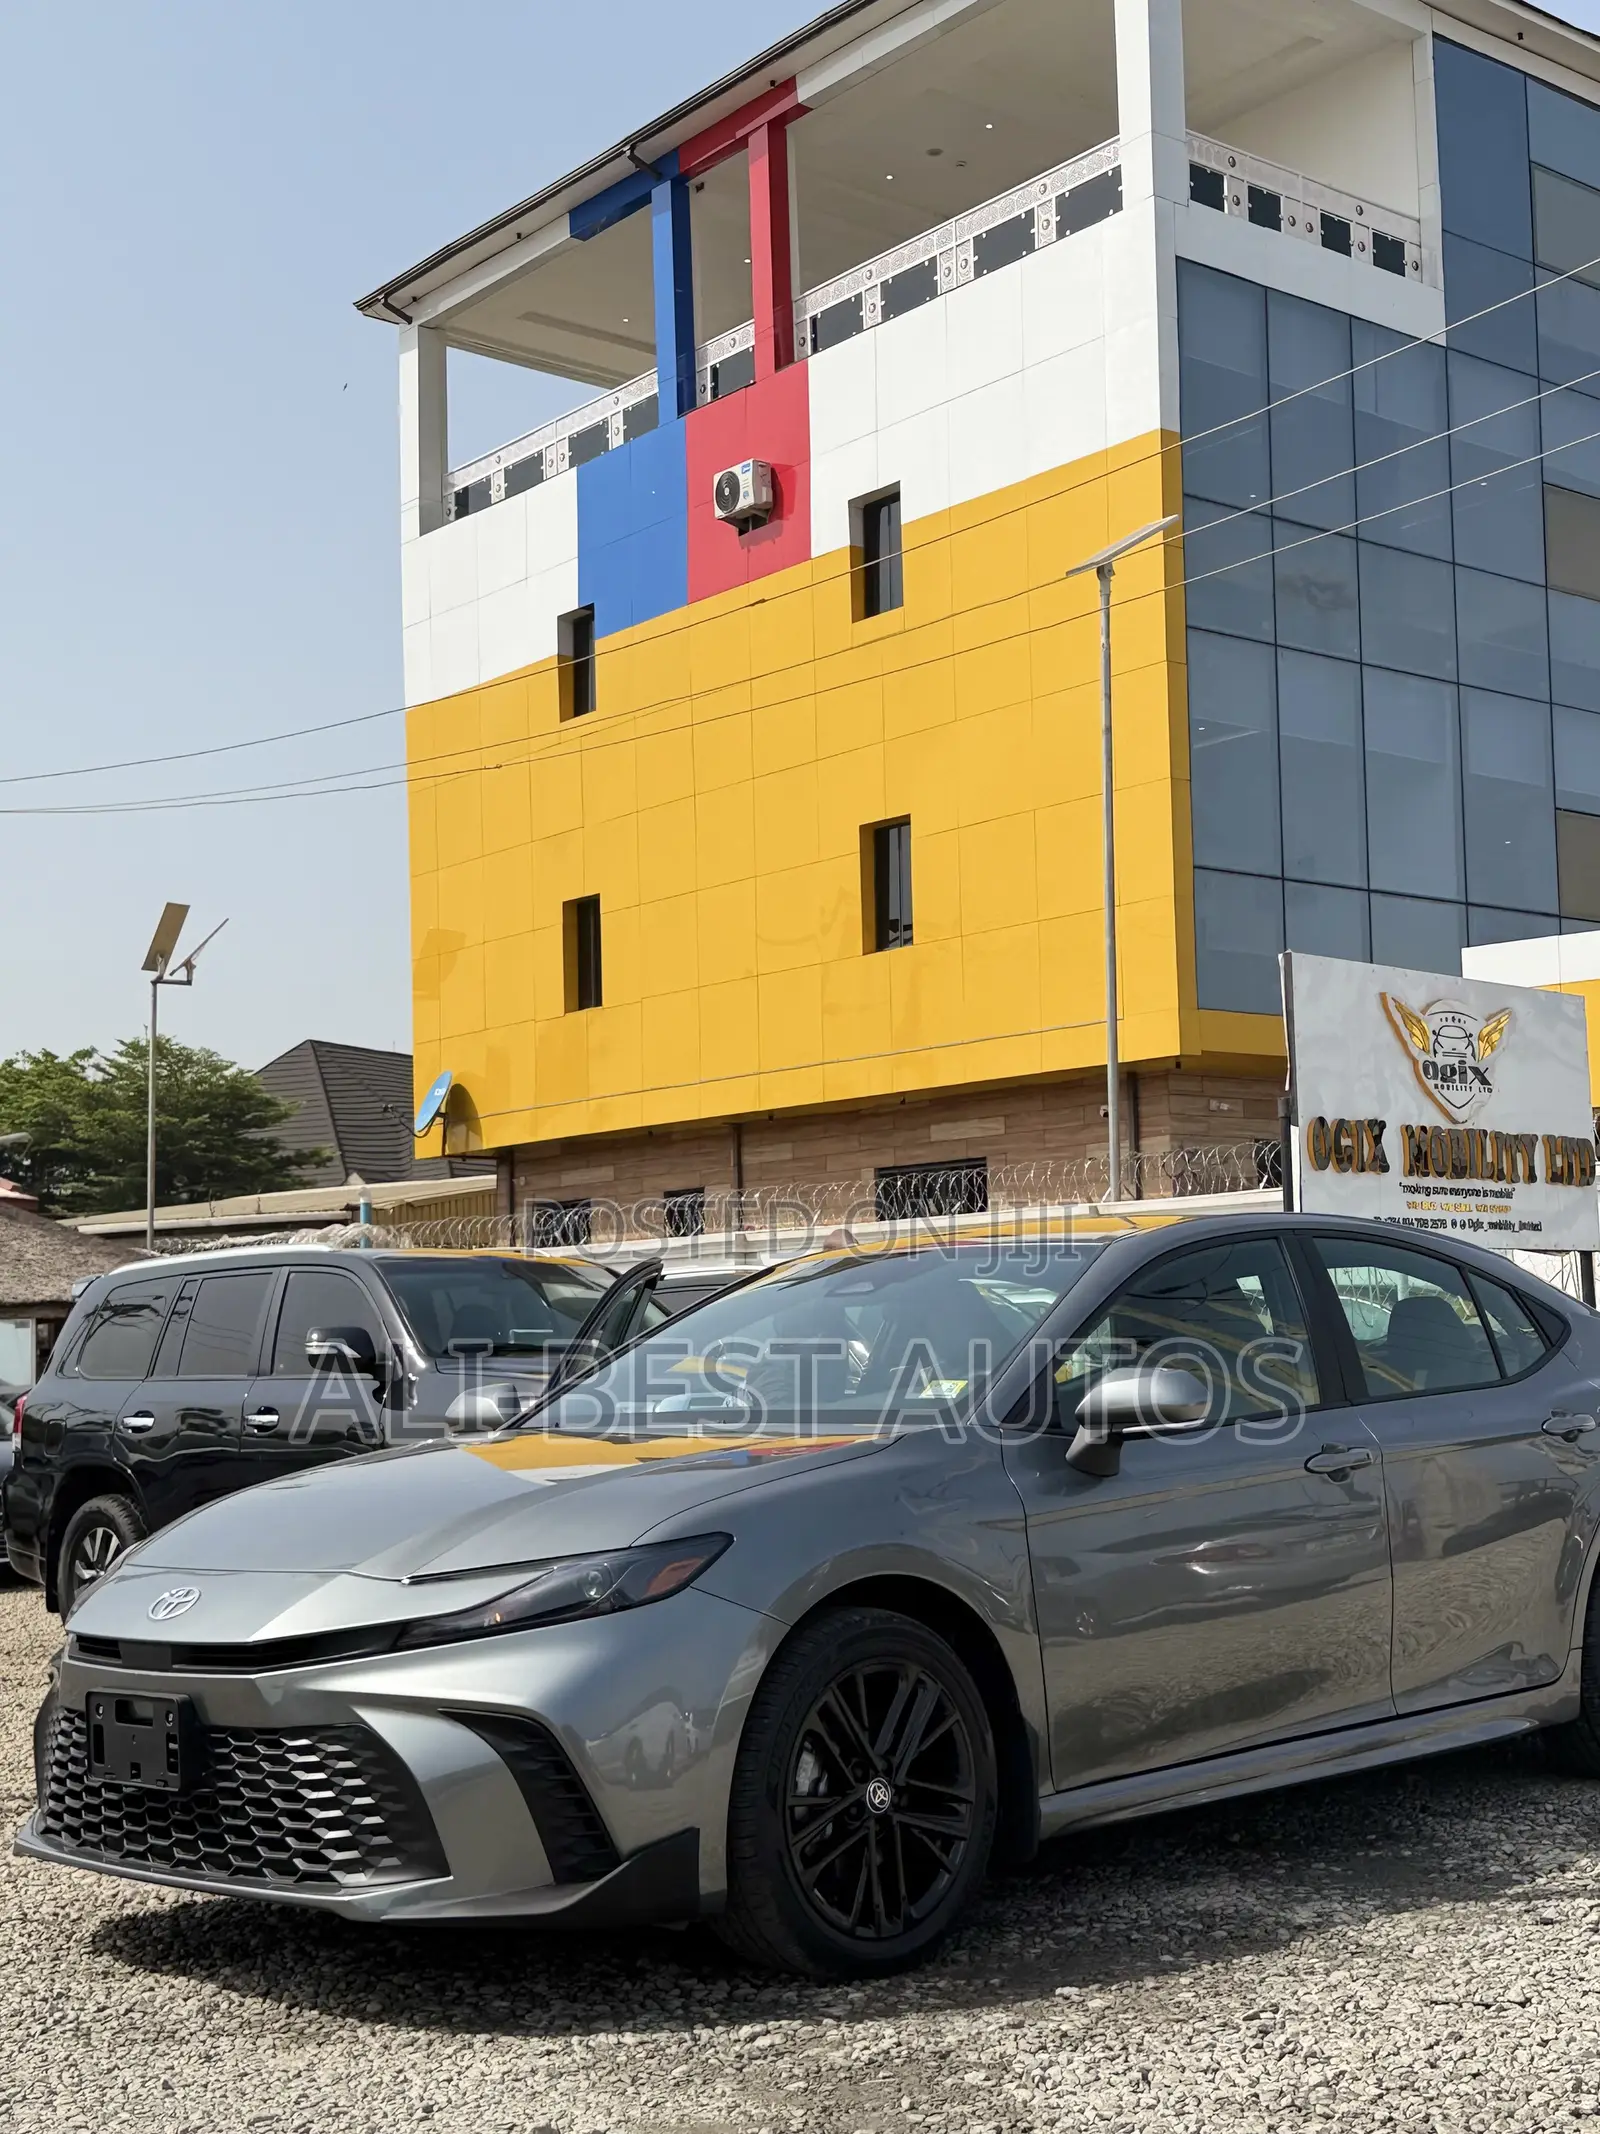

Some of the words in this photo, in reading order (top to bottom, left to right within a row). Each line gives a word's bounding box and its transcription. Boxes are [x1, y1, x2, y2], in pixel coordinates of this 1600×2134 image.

[1434, 1083, 1473, 1093] MOBILITY
[1478, 1086, 1493, 1094] LTD
[1307, 1115, 1390, 1175] OGIX
[1400, 1123, 1539, 1185] MOBILITY
[1542, 1133, 1596, 1187] LTD
[1482, 1186, 1489, 1198] is
